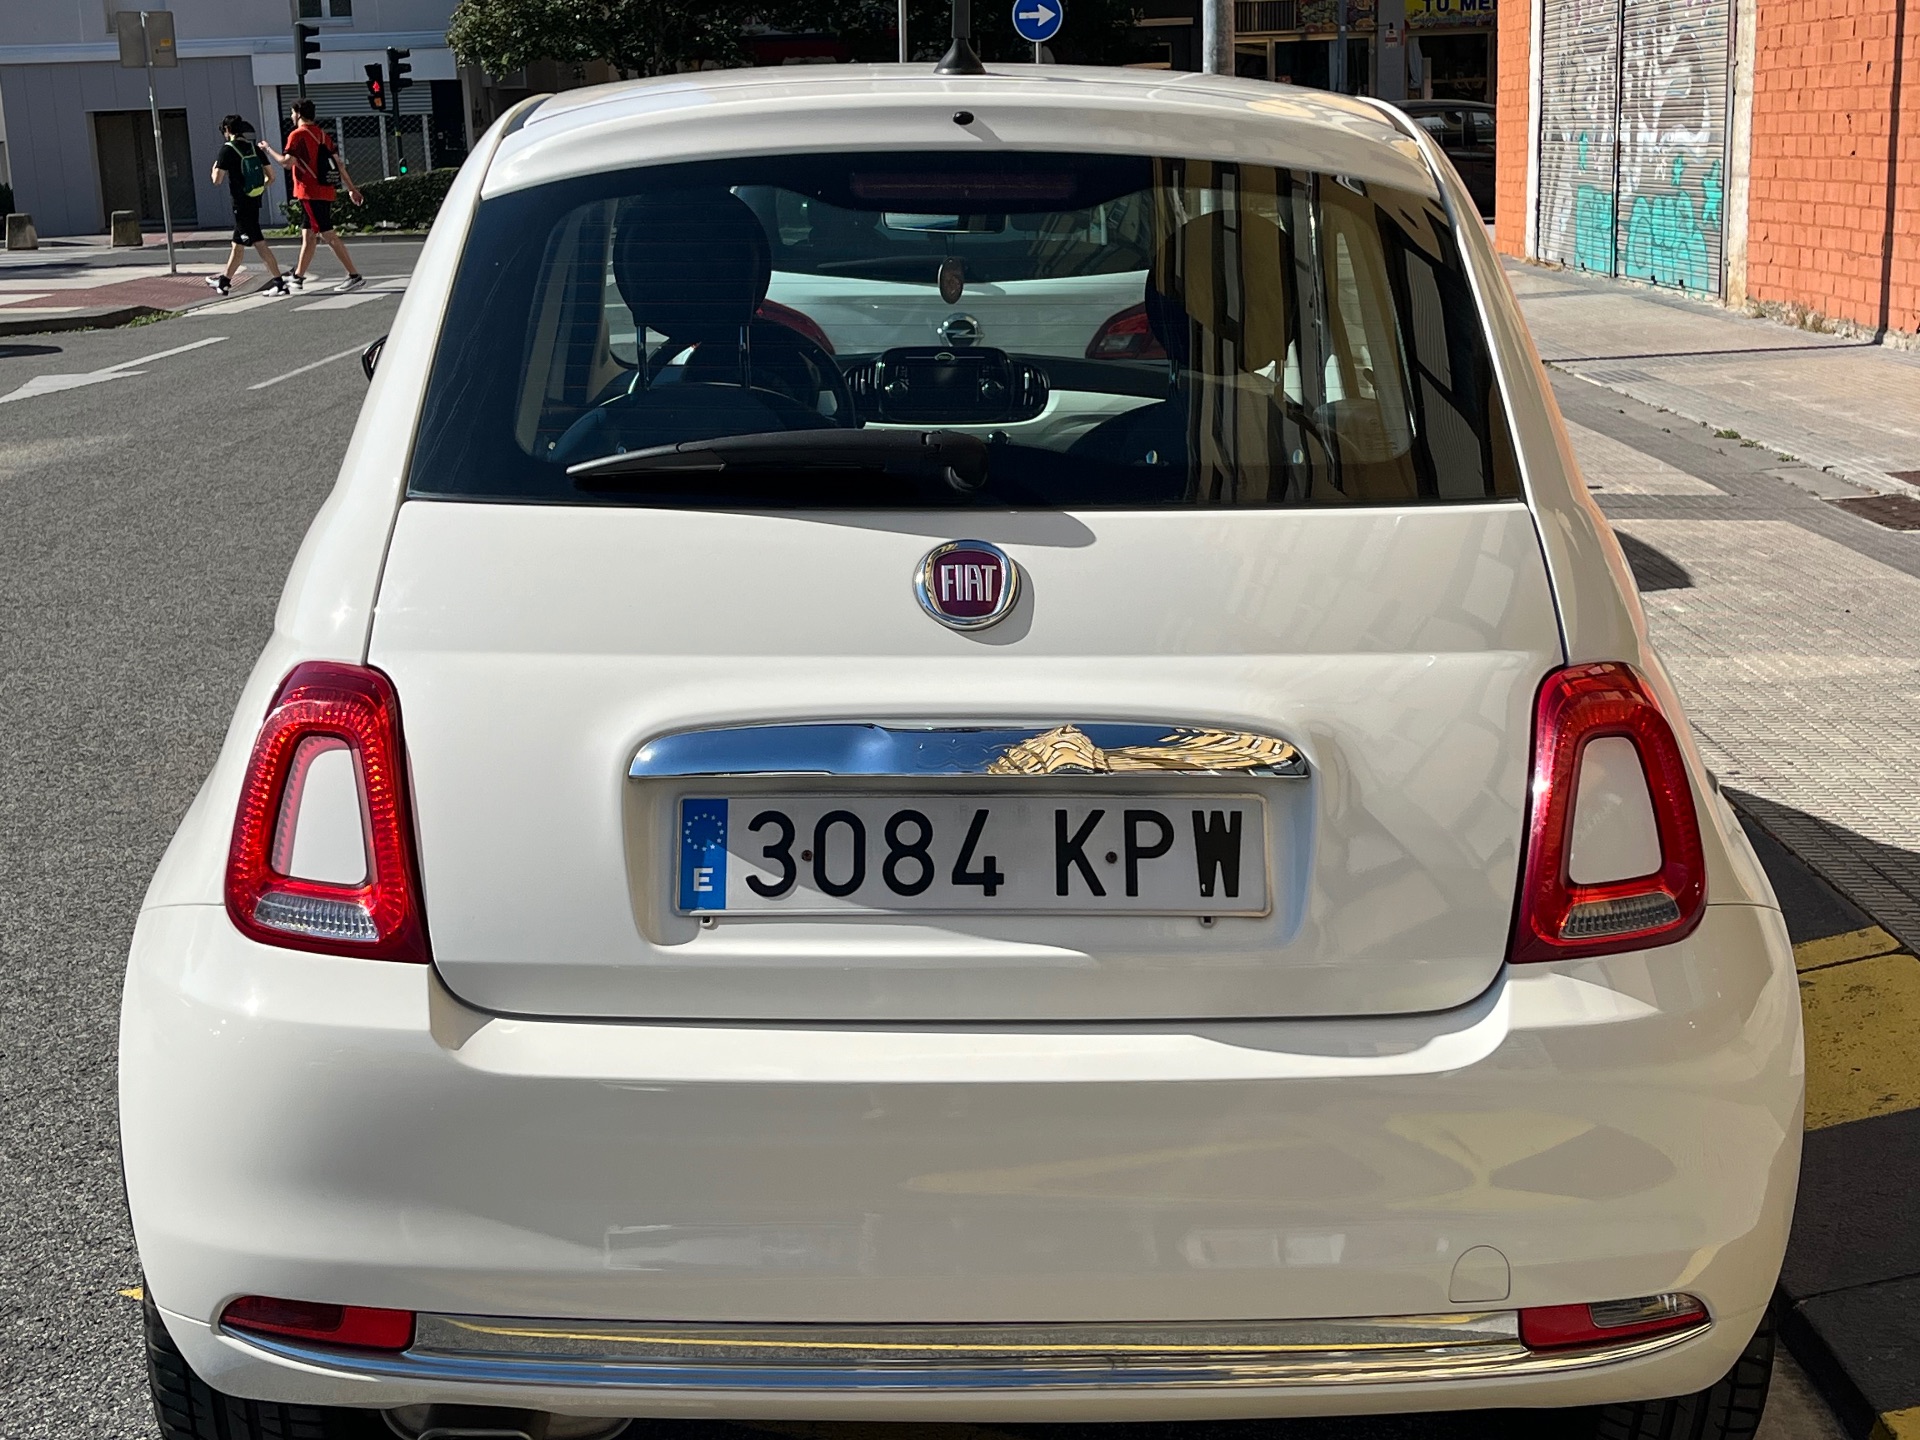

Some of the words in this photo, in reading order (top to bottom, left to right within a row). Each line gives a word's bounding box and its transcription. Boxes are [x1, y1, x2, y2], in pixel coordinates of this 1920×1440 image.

[1422, 0, 1449, 12] TU
[1461, 0, 1497, 11] ME
[941, 564, 997, 602] FIAT
[746, 809, 1005, 897] 3084
[1055, 809, 1242, 898] KPW
[693, 867, 714, 892] E
